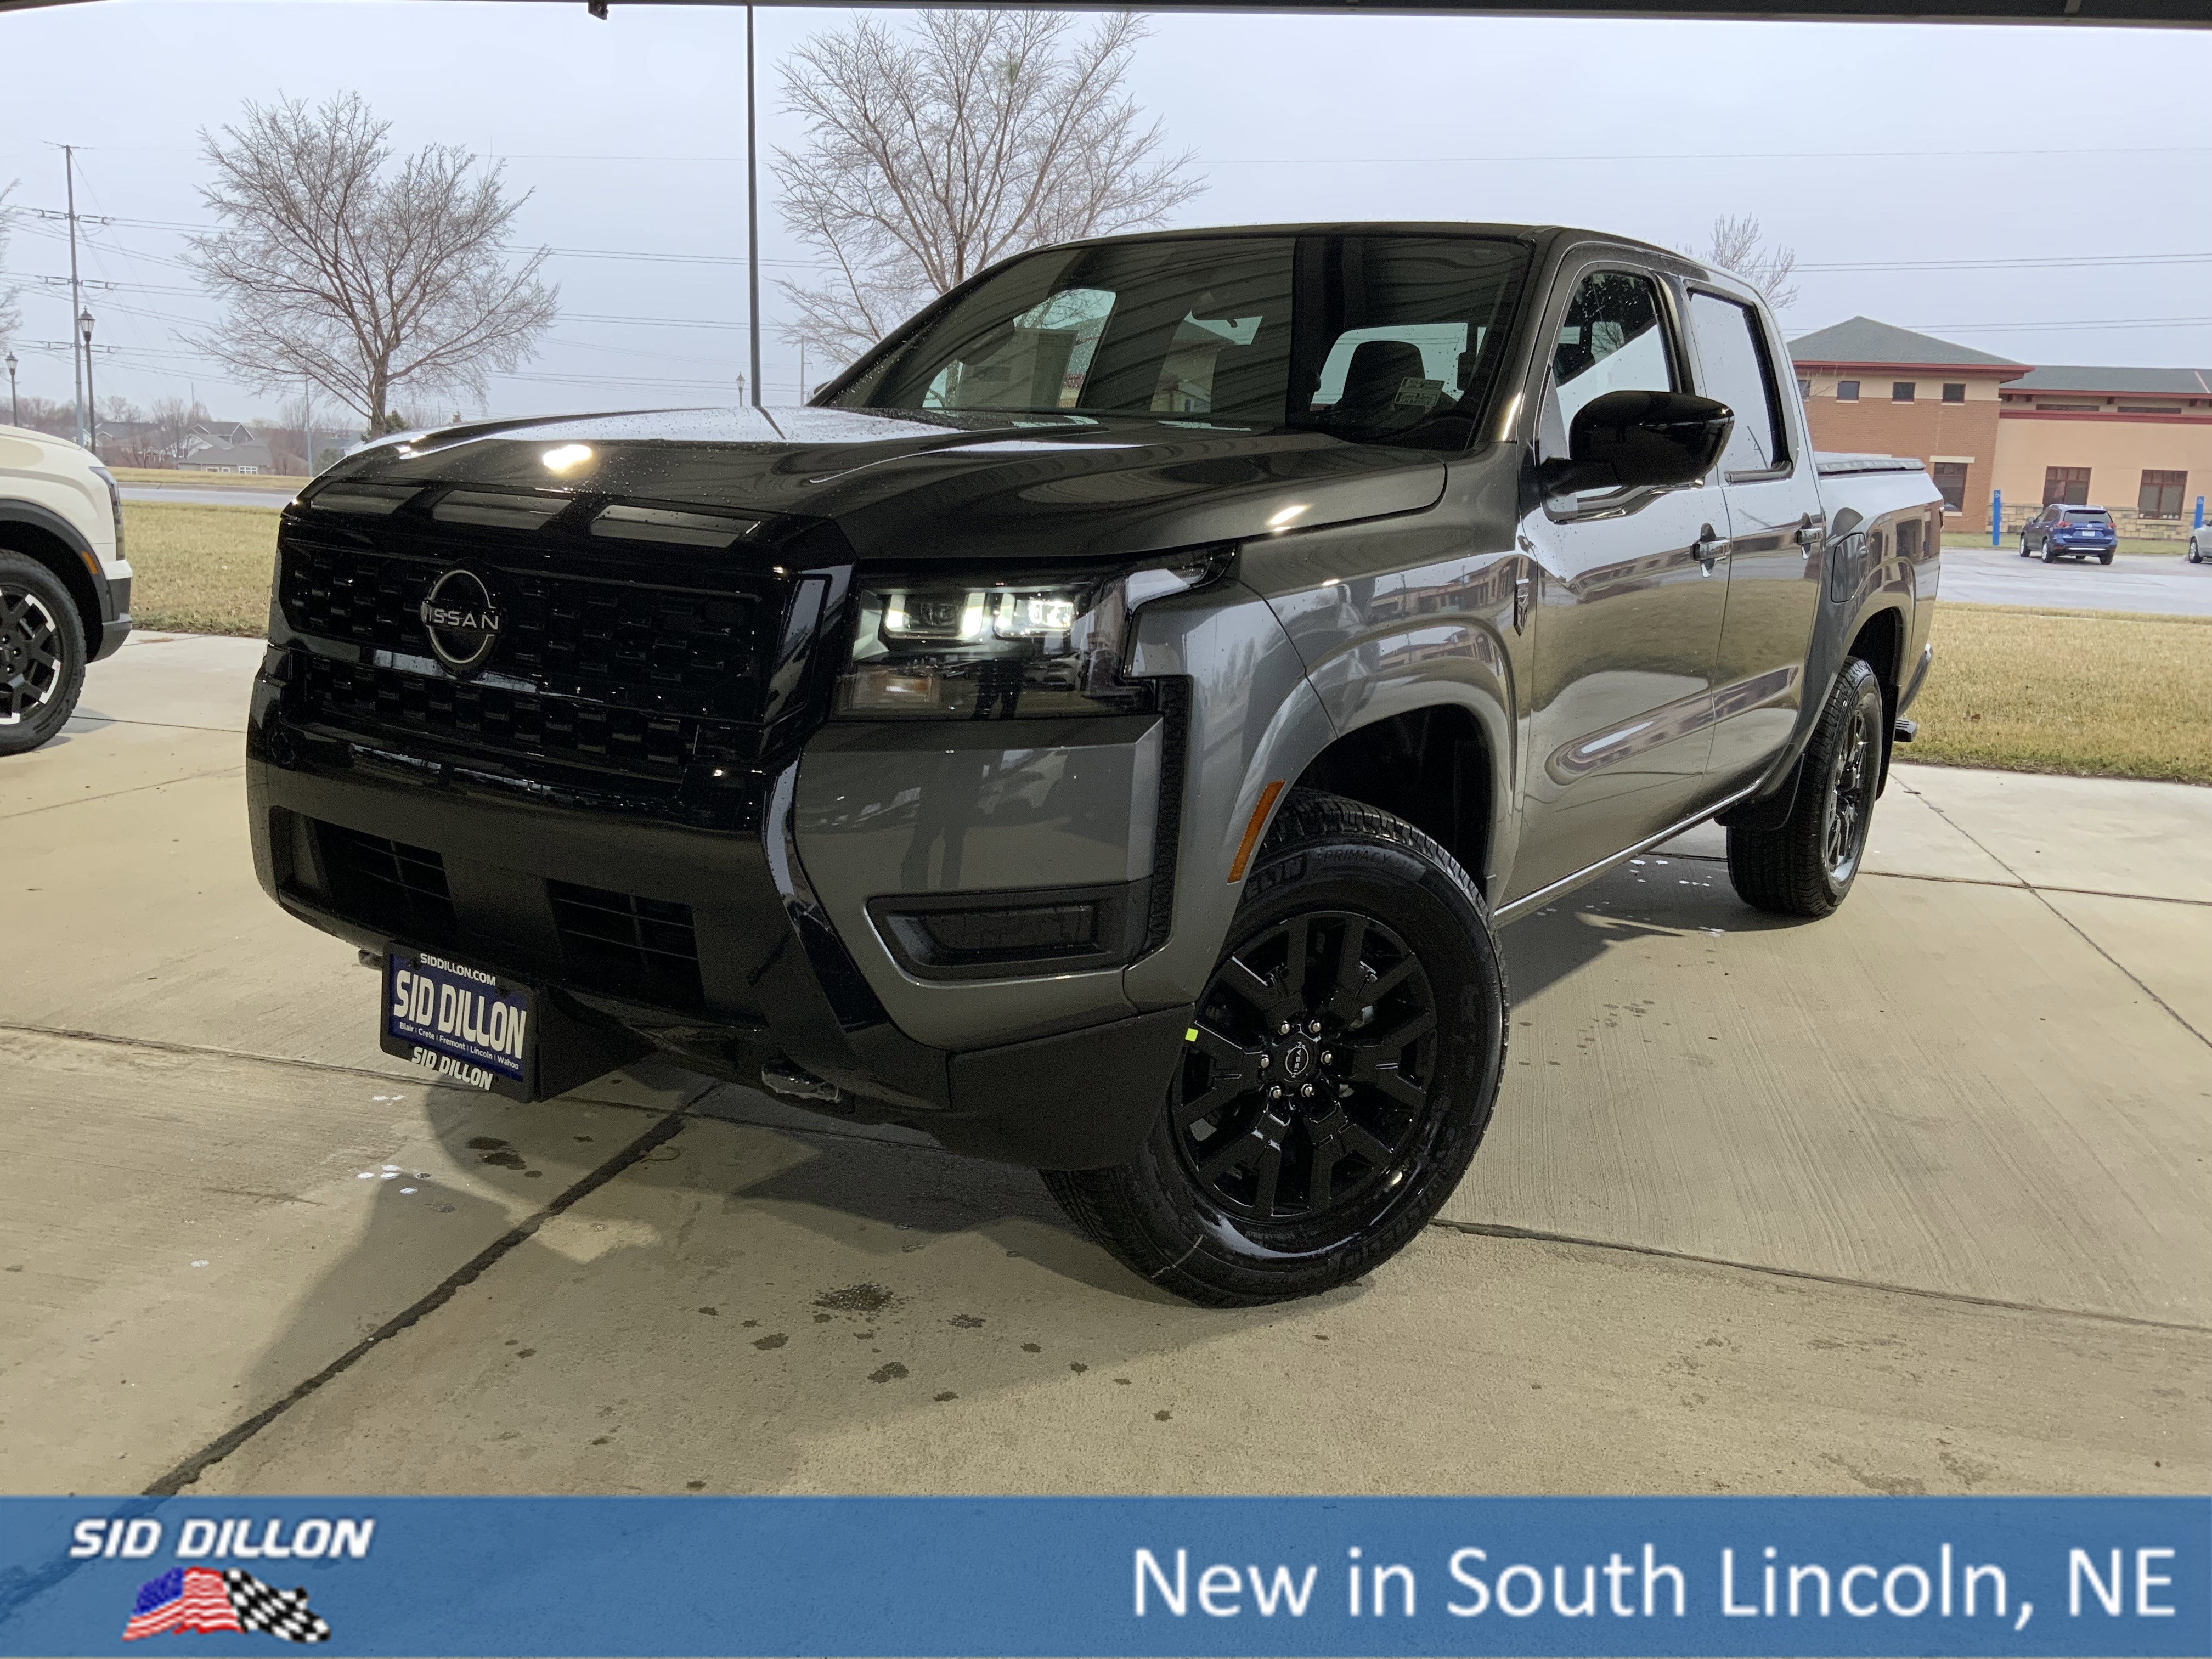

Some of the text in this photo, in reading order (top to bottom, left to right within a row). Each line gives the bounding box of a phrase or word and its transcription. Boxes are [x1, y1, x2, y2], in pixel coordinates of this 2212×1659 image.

[421, 603, 499, 630] NISSAN
[1323, 848, 1391, 866] PRIMACY
[420, 953, 496, 986] SIDDILLON.COM
[393, 969, 527, 1059] SID DILLON
[399, 1022, 519, 1070] Blair Crete Fremont Lincoln Wahoo
[412, 1046, 493, 1091] SID DILLON
